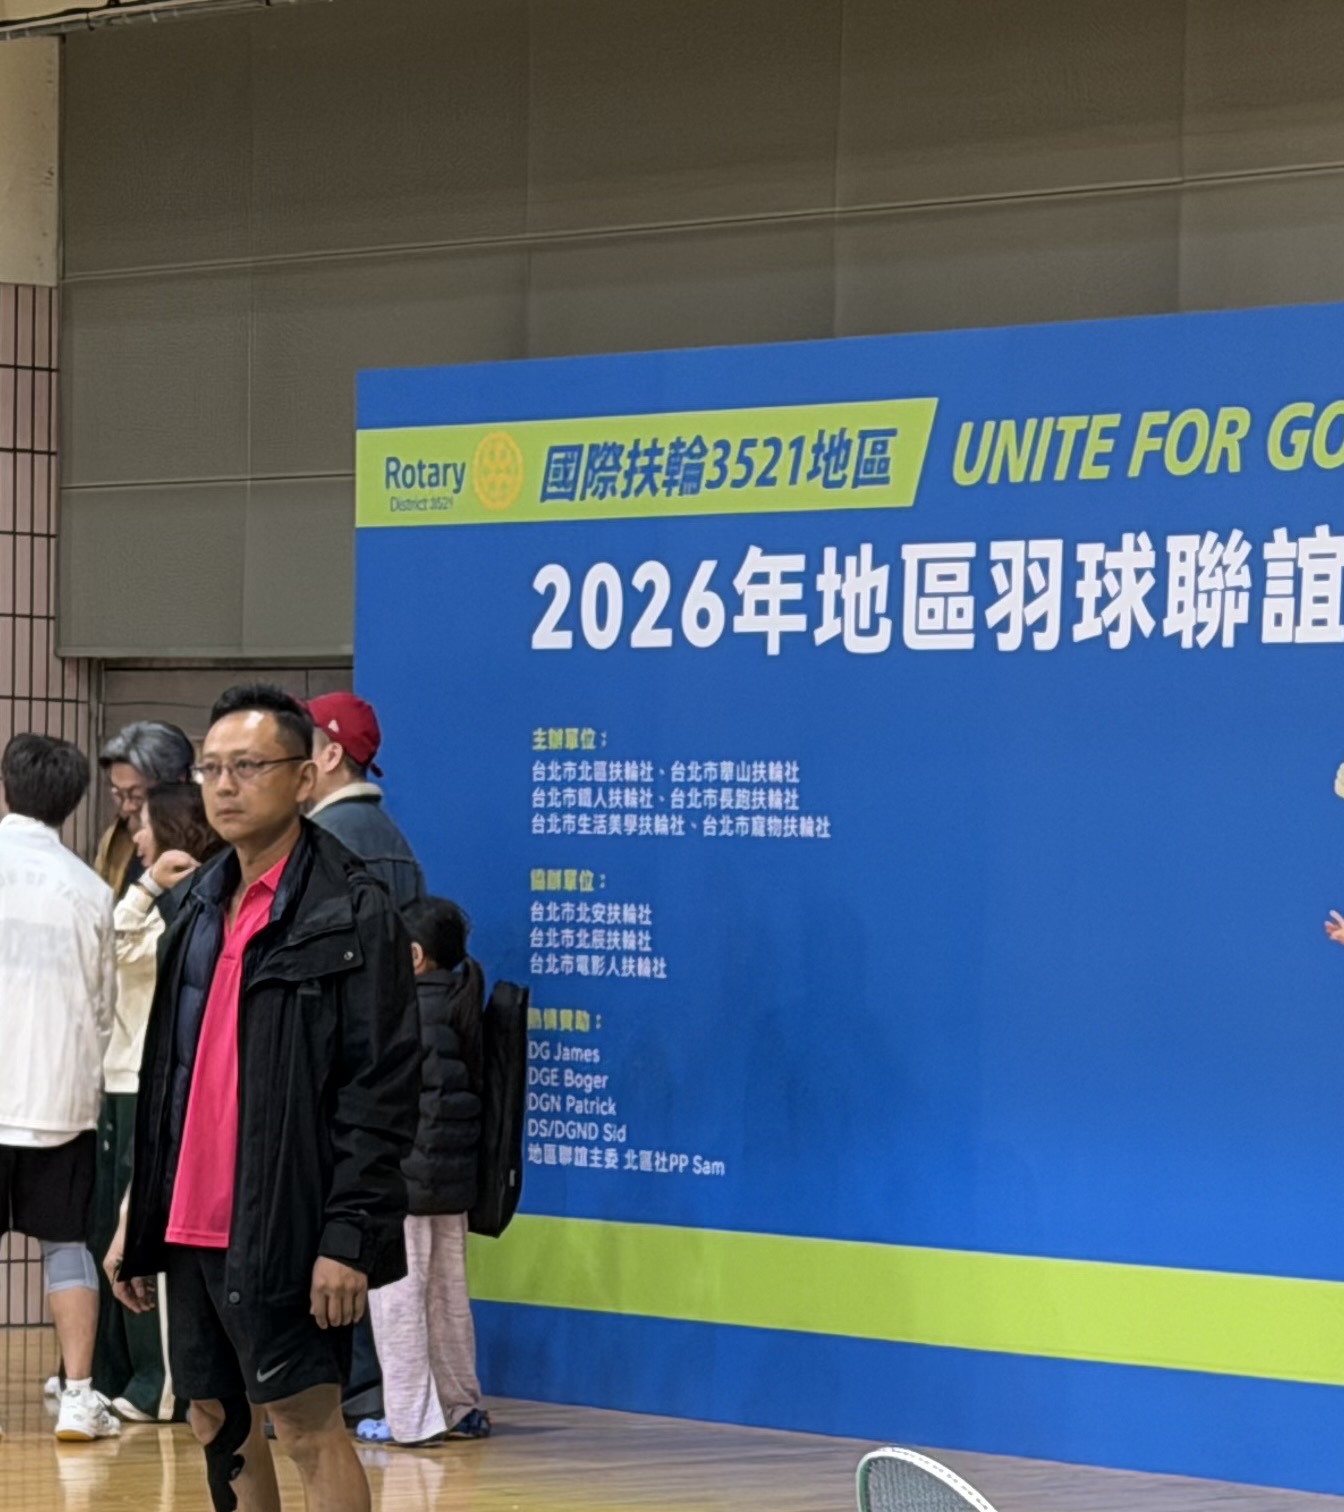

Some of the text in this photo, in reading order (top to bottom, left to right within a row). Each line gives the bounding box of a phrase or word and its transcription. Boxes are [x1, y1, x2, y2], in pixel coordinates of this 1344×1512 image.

[952, 412, 1122, 487] UNITE
[1127, 406, 1251, 479] FOR
[384, 456, 467, 495] Rotary
[539, 426, 898, 504] 國際扶輪3521地區
[529, 901, 653, 926] 台北市北安扶輪社
[529, 952, 667, 979] 台北市電影人扶輪社
[527, 1040, 600, 1063] DG James
[528, 1066, 560, 1086] DGE
[527, 1092, 617, 1116] DGN Patrick
[527, 1118, 599, 1141] DS/DGND
[692, 1155, 726, 1177] Sam
